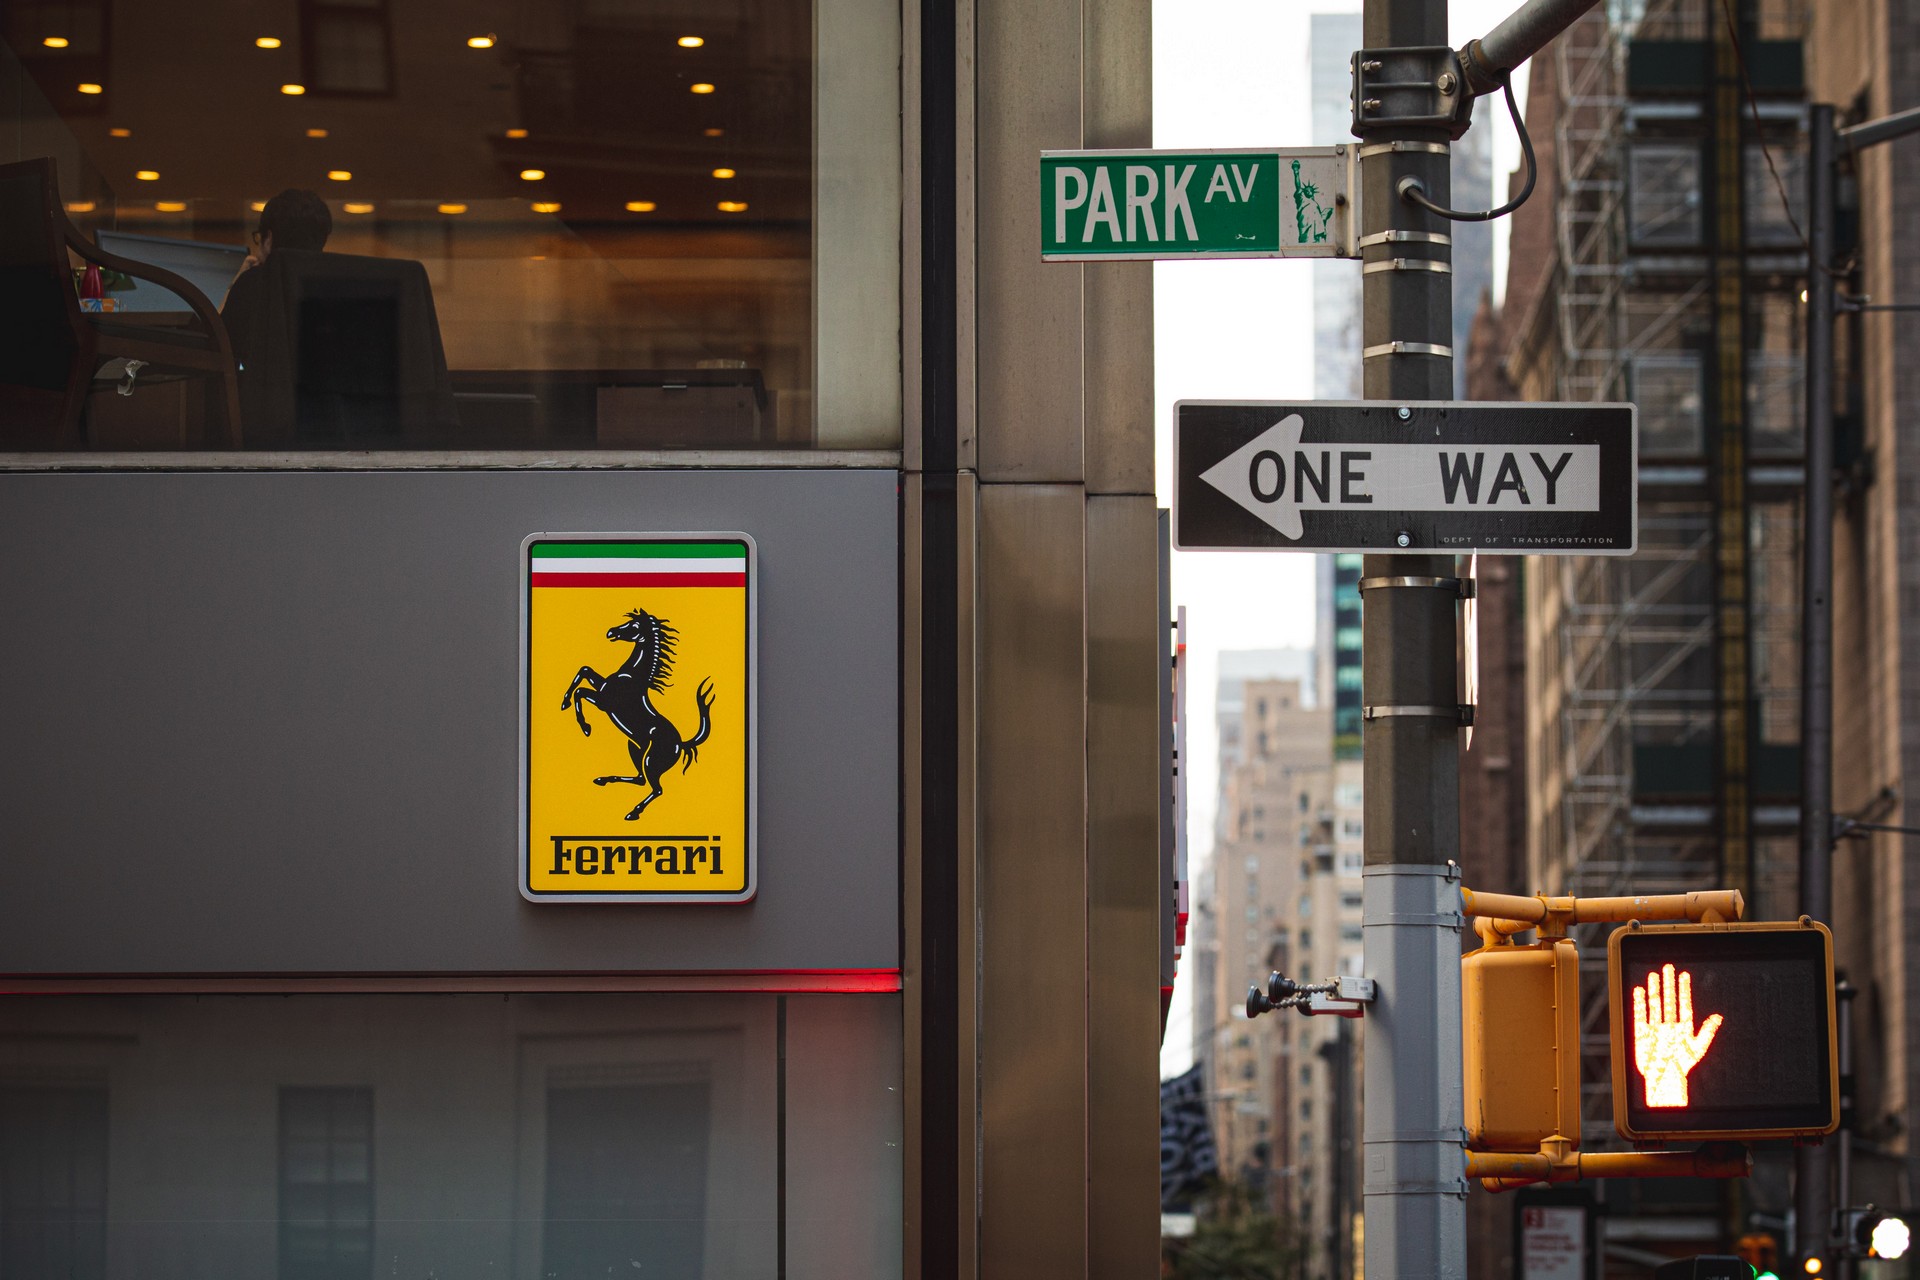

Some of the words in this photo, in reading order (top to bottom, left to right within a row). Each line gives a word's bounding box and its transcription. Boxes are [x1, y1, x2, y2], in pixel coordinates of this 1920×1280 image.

[1055, 164, 1200, 243] PARK
[1204, 163, 1260, 203] AV
[1248, 449, 1373, 504] ONE
[1438, 451, 1573, 505] WAY
[548, 835, 724, 875] Ferrari
